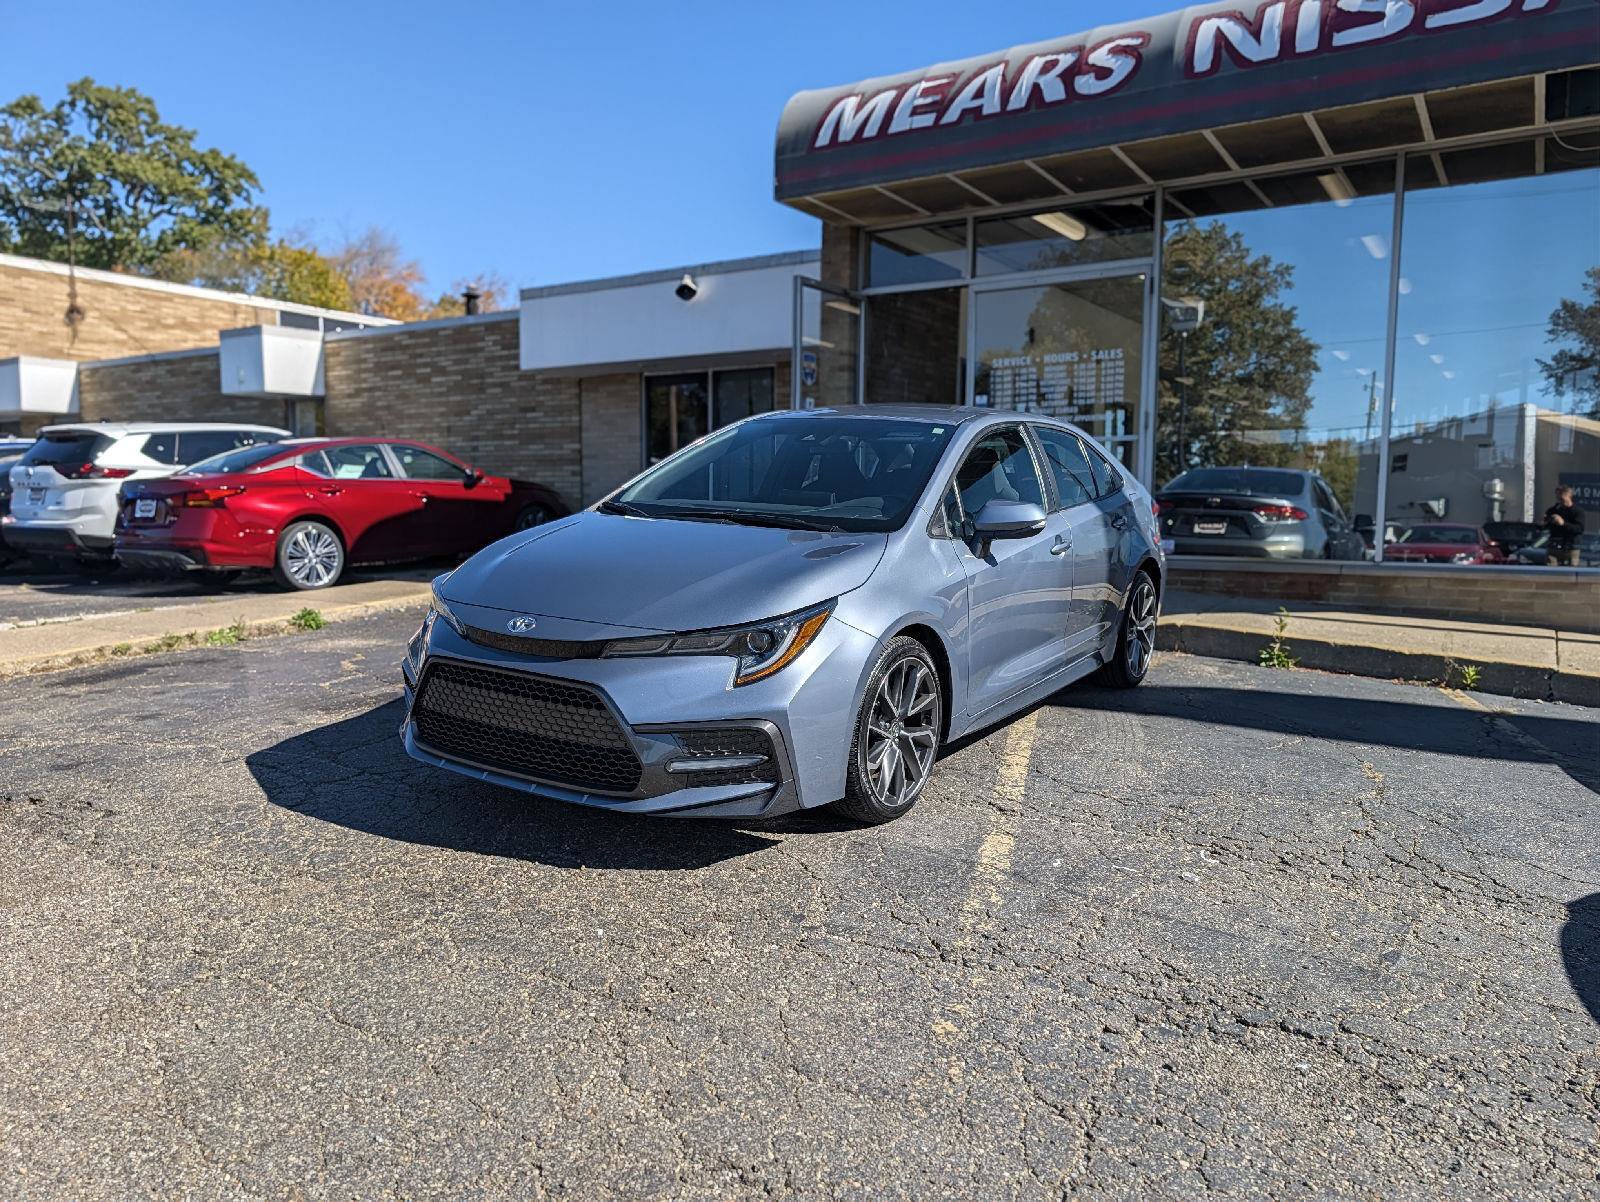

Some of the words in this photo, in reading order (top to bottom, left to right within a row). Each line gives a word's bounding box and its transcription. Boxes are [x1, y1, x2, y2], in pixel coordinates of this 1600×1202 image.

[812, 35, 1147, 148] MEARS
[1043, 351, 1080, 363] HOURS
[1090, 348, 1124, 360] SALES
